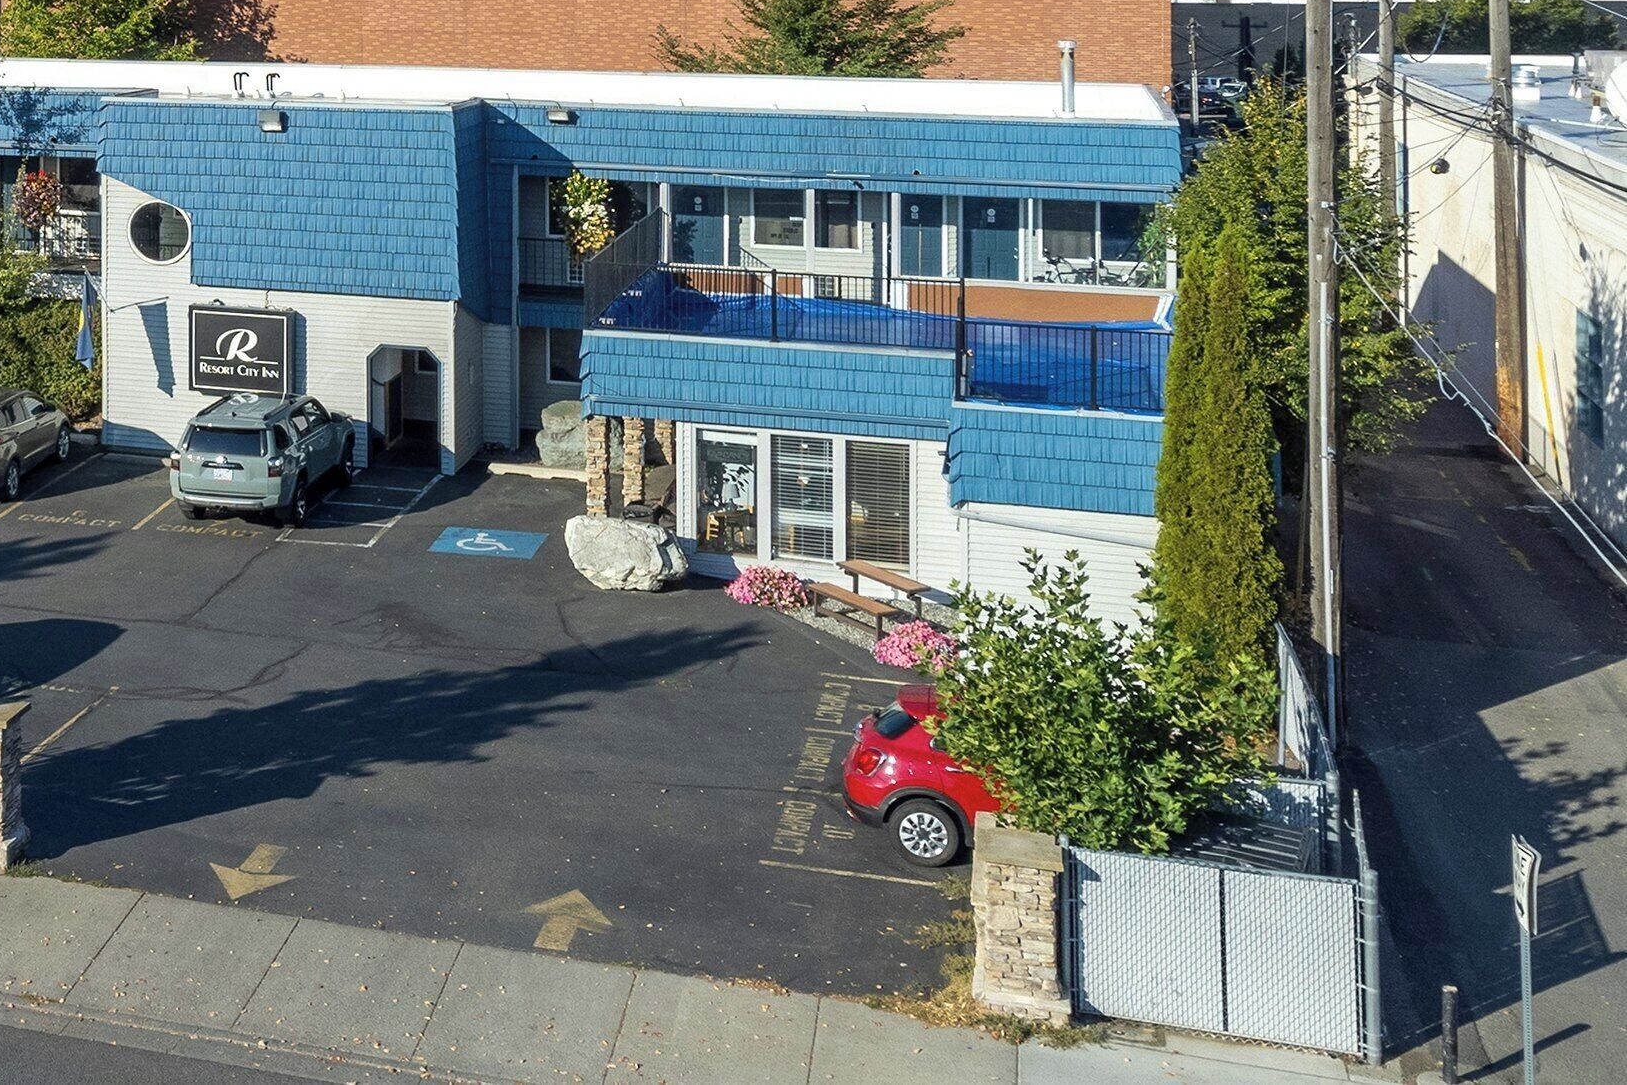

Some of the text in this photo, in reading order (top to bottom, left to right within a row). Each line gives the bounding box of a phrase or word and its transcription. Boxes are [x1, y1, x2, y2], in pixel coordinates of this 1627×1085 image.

[215, 328, 258, 362] R
[199, 361, 279, 379] RESORT CITY INN
[18, 514, 122, 528] COMPACT
[155, 523, 264, 537] COMPACT
[813, 681, 852, 725] COMPACT
[794, 735, 837, 782] COMPACT
[772, 800, 818, 856] COMPACT
